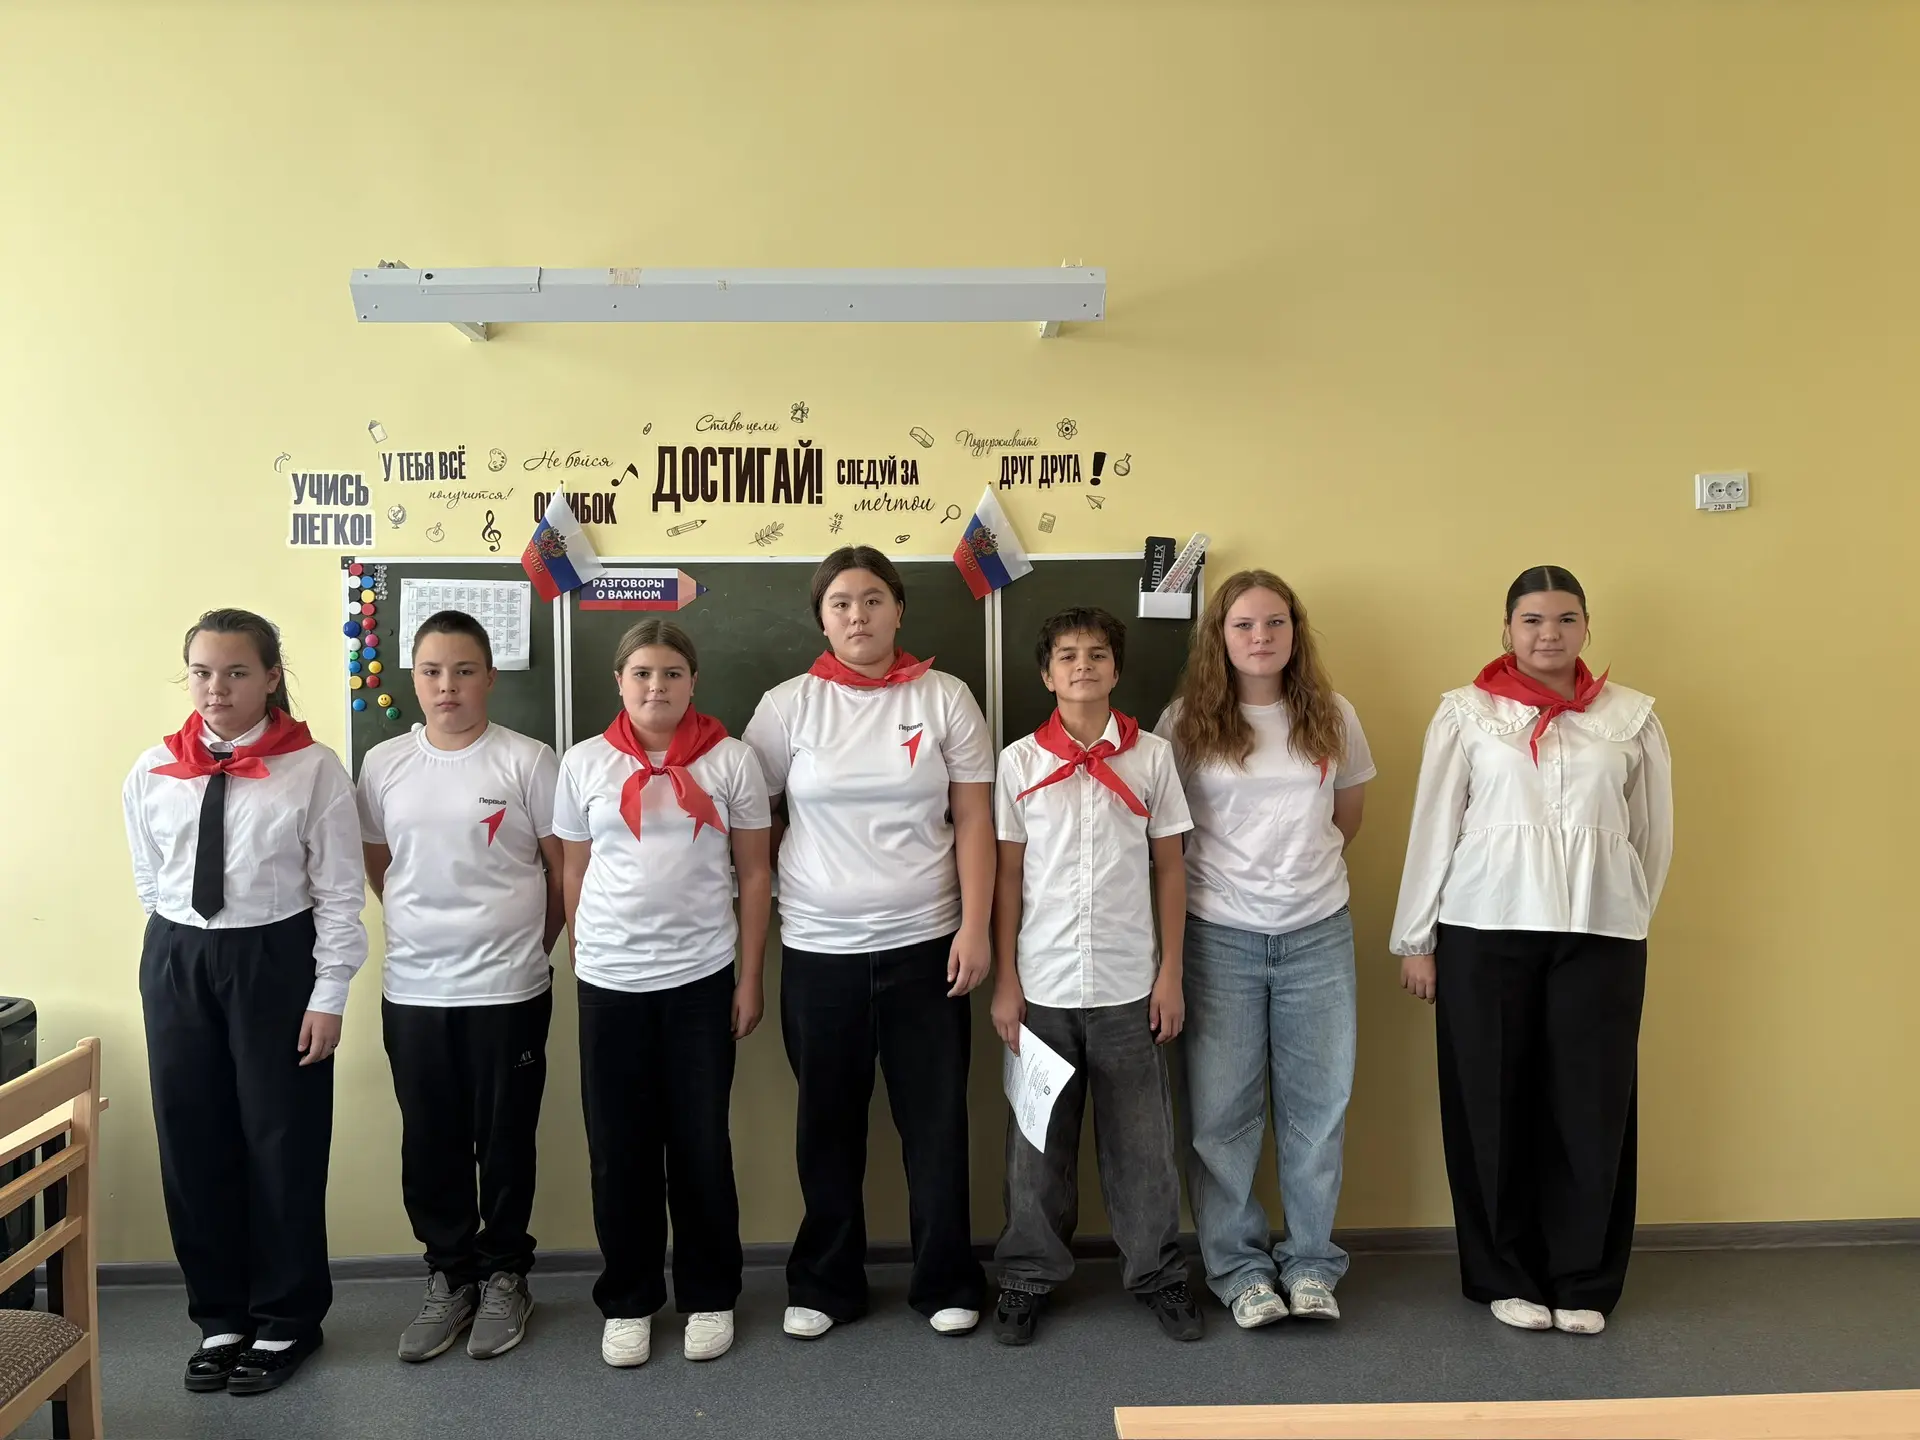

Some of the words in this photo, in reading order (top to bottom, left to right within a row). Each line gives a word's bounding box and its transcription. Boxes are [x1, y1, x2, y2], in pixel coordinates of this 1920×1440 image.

[694, 411, 744, 432] Ставь
[746, 422, 779, 434] цели
[955, 429, 1039, 457] Поддерживайте
[382, 452, 393, 482] У
[396, 451, 435, 481] ТЕБЯ
[438, 444, 467, 480] ВСЁ
[522, 450, 562, 471] Не
[565, 450, 614, 468] бойся
[837, 455, 897, 490] СЛЕДУЙ
[900, 459, 919, 485] ЗА
[999, 455, 1034, 490] ДРУГ
[652, 439, 823, 513] ДОСТИГАЙ!
[291, 473, 369, 506] УЧИСЬ
[428, 487, 514, 509] получится!
[533, 491, 618, 525] ОИБОК
[1713, 503, 1725, 511] 220
[290, 513, 372, 545] ЛЕГКО!
[592, 578, 665, 588] РАЗГОВОРЫ
[596, 589, 605, 600] О
[607, 589, 661, 600] ВАЖНОМ
[898, 722, 924, 733] Первые
[478, 796, 507, 806] Первые
